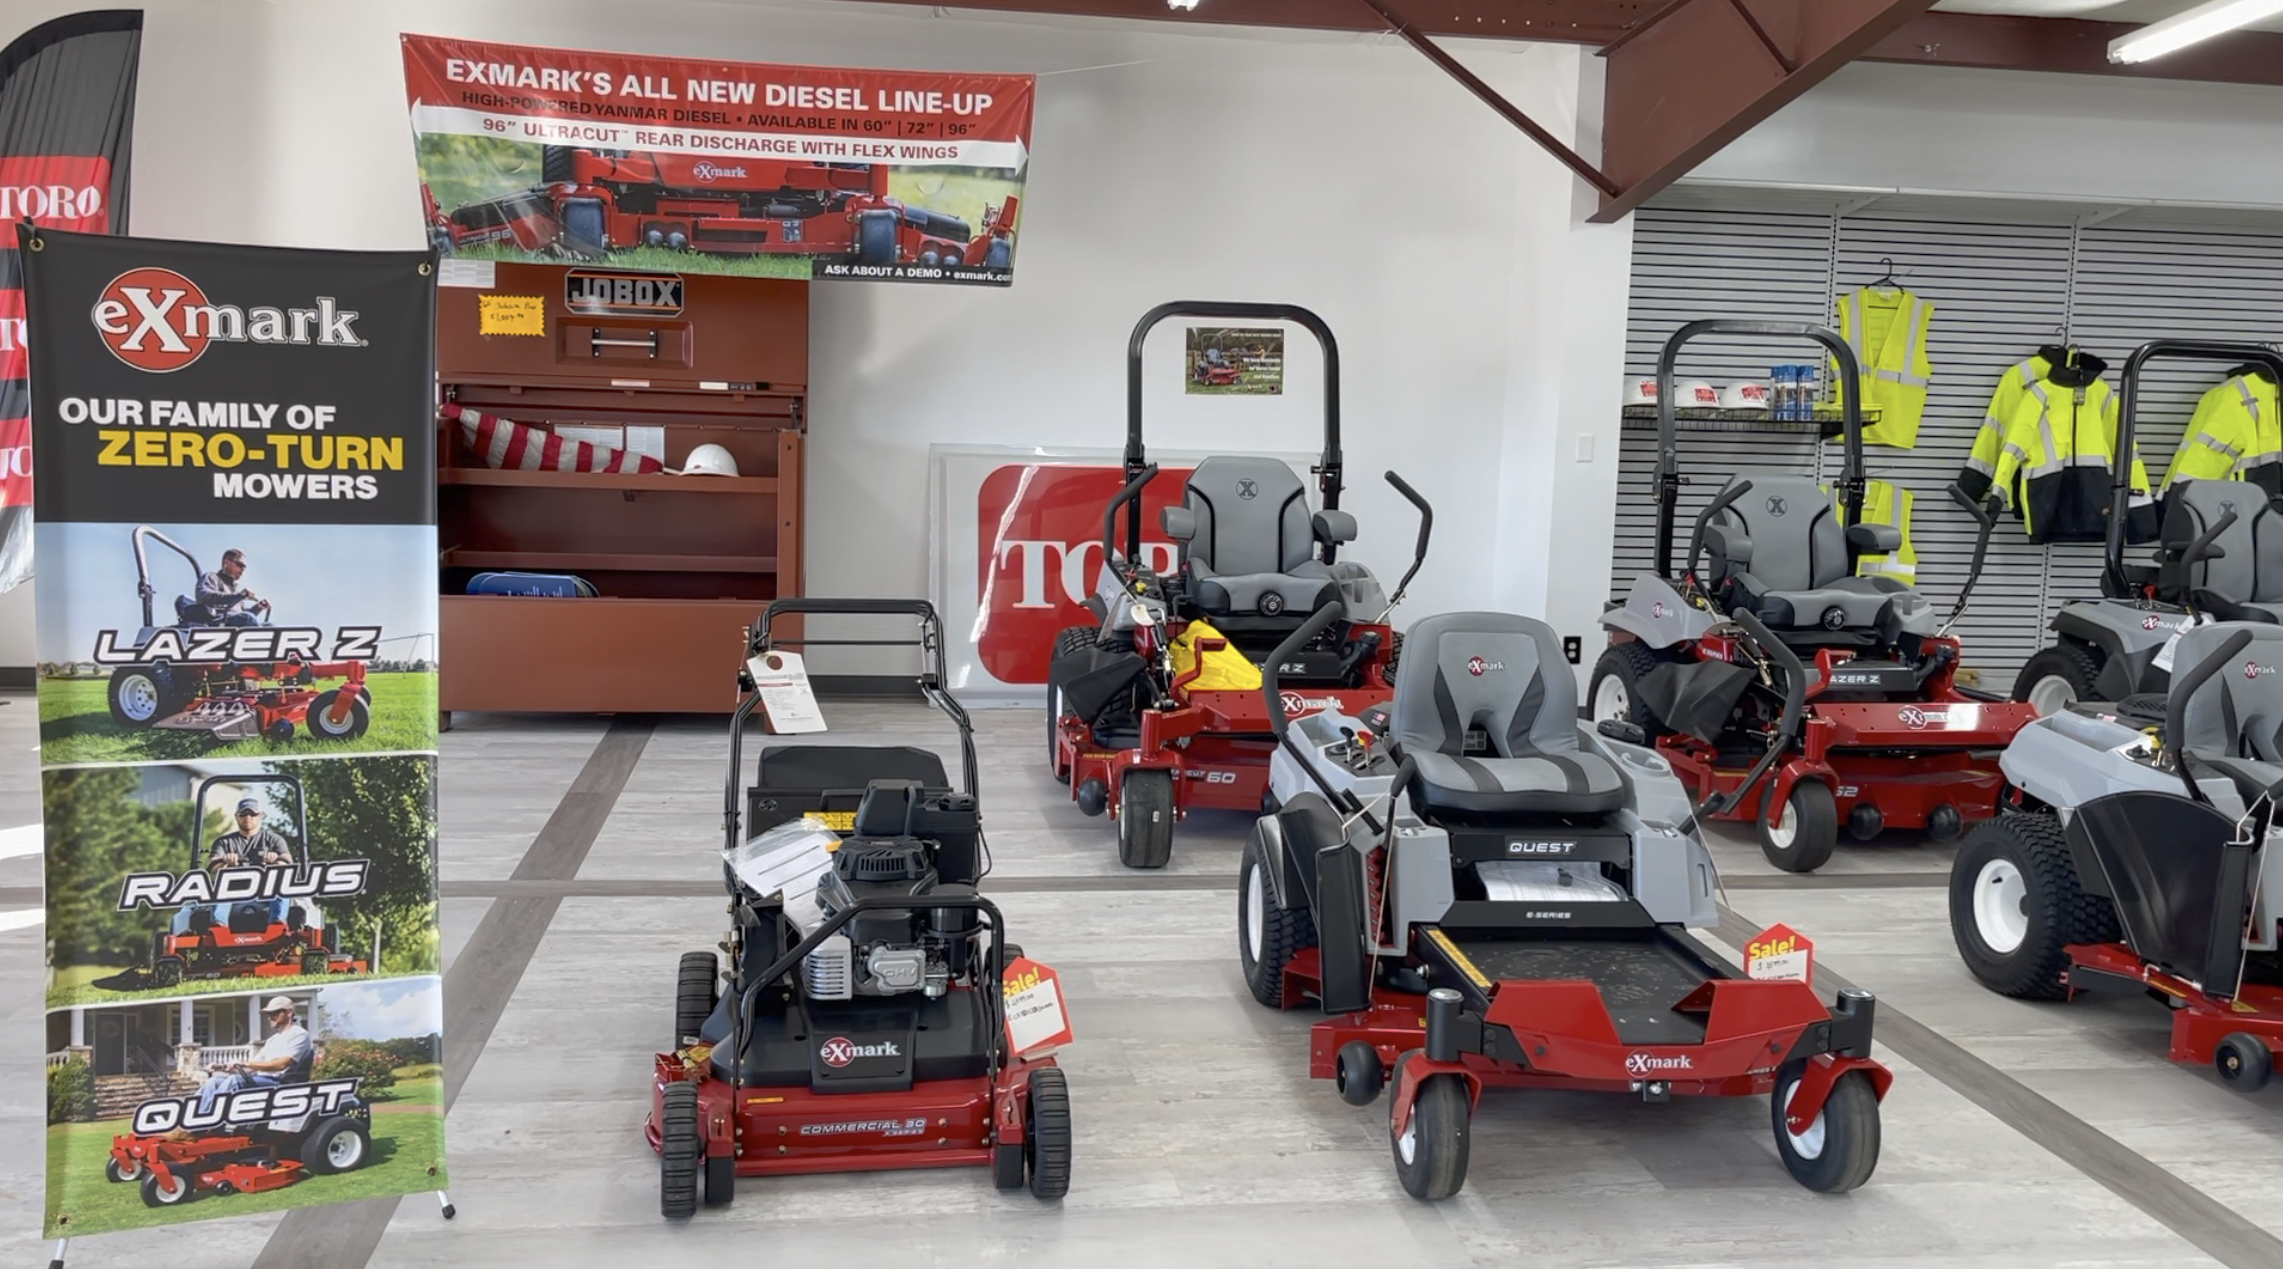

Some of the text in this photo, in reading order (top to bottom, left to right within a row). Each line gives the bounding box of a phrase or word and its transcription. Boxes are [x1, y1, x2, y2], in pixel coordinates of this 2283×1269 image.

[446, 58, 993, 115] EXMARK'S ALL NEW DIESEL LINE-UP
[462, 91, 592, 115] HIGH-POWERED
[594, 102, 668, 121] YANMAR
[673, 109, 731, 124] DIESEL
[747, 114, 836, 129] AVAILABLE
[841, 118, 858, 131] IN
[635, 131, 684, 147] REAR
[690, 134, 797, 153] DISCHARGE
[800, 141, 846, 156] WITH
[852, 143, 896, 158] FLEX
[900, 146, 958, 159] WINGS
[824, 264, 849, 276] ASK
[852, 266, 893, 278] ABOUT
[894, 267, 904, 277] A
[907, 268, 942, 279] DEMO
[571, 277, 677, 307] JOBOX
[92, 285, 363, 353] eXmark
[59, 396, 336, 430] OUR FAMILY OF
[98, 430, 404, 471] ZERO-TURN
[213, 473, 379, 500] MOWERS
[96, 627, 380, 662] LAZER Z
[1830, 674, 1866, 683] AZER
[1206, 771, 1236, 784] 60
[1509, 842, 1574, 853] QUEST
[119, 861, 367, 909] RADIUS
[1526, 911, 1572, 919] E-SERIES
[1748, 935, 1796, 960] Sale!
[820, 1041, 901, 1063] eXmark
[1625, 1054, 1693, 1073] eXmark
[133, 1079, 360, 1135] QUEST
[801, 1118, 926, 1136] COMMERCIAL 30
